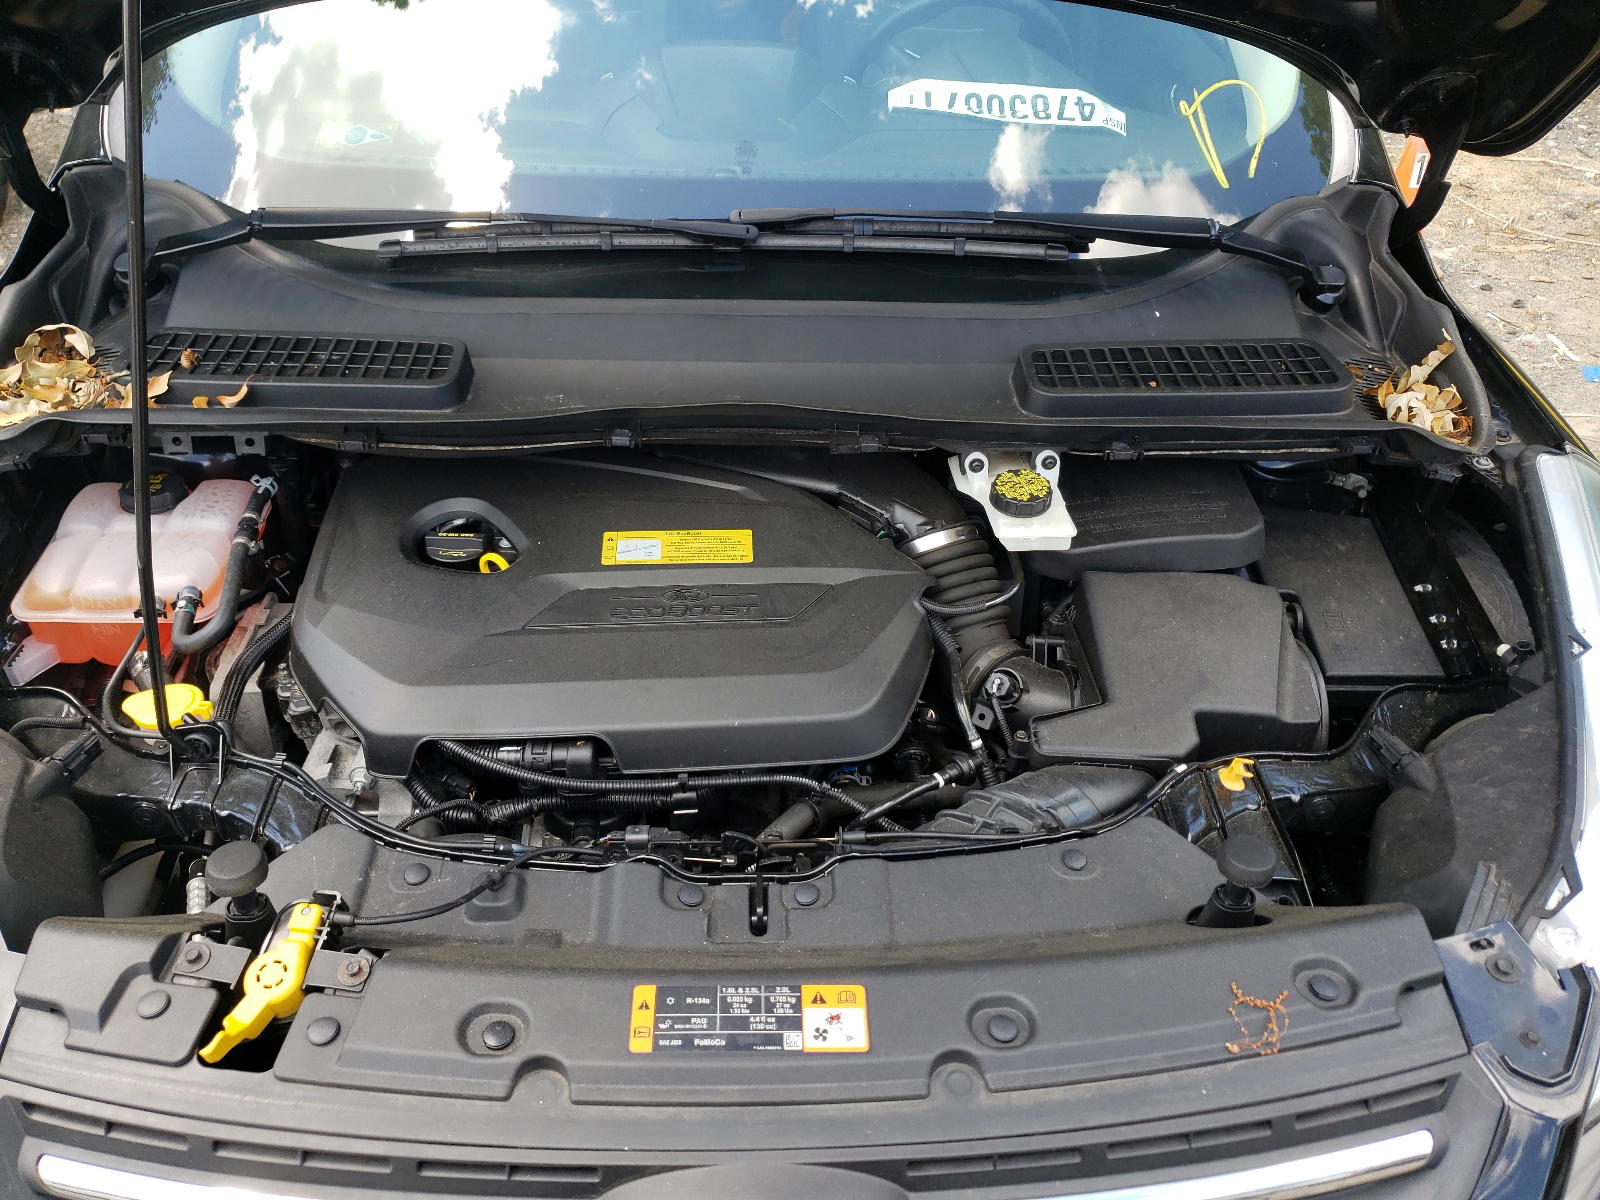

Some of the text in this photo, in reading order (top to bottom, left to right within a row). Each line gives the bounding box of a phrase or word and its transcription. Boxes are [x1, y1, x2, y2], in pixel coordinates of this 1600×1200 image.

[744, 996, 753, 1004] kg
[787, 996, 796, 1004] kg
[694, 1038, 726, 1046] FoMoCo
